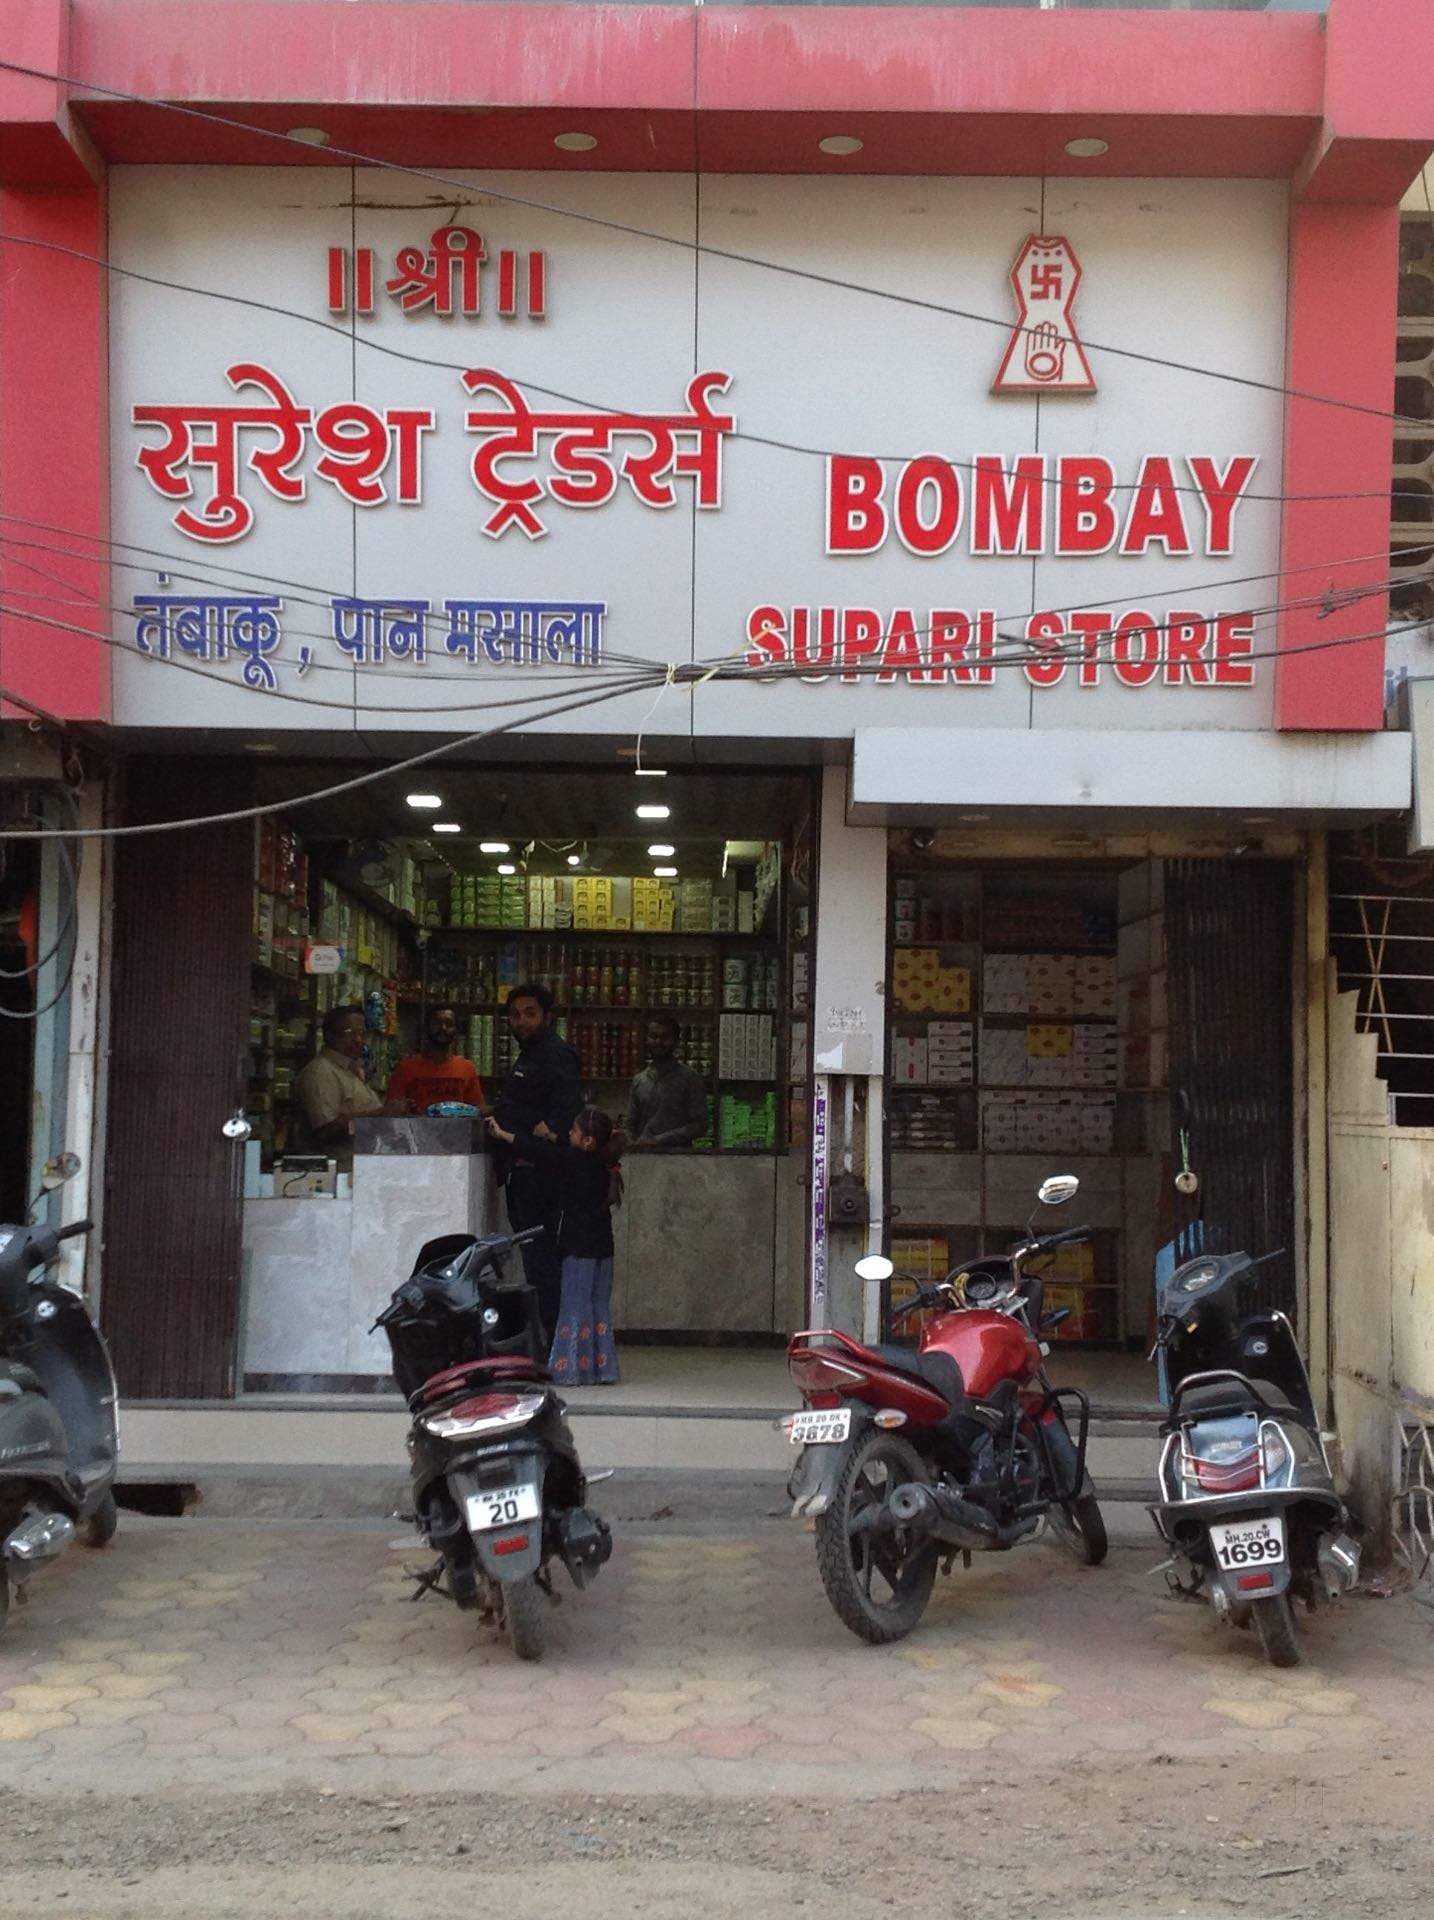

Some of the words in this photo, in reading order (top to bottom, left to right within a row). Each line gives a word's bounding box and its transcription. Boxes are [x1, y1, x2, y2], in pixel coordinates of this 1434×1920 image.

[131, 363, 435, 544] सुरेश
[461, 368, 737, 540] ट्रेडर्स
[826, 453, 1260, 557] BOMBAY
[331, 598, 432, 664] पान
[443, 600, 607, 666] मसाला
[746, 605, 996, 685] SUPARI
[1023, 610, 1255, 687] STORE
[489, 1500, 519, 1524] 20
[1218, 1538, 1282, 1566] 1699
